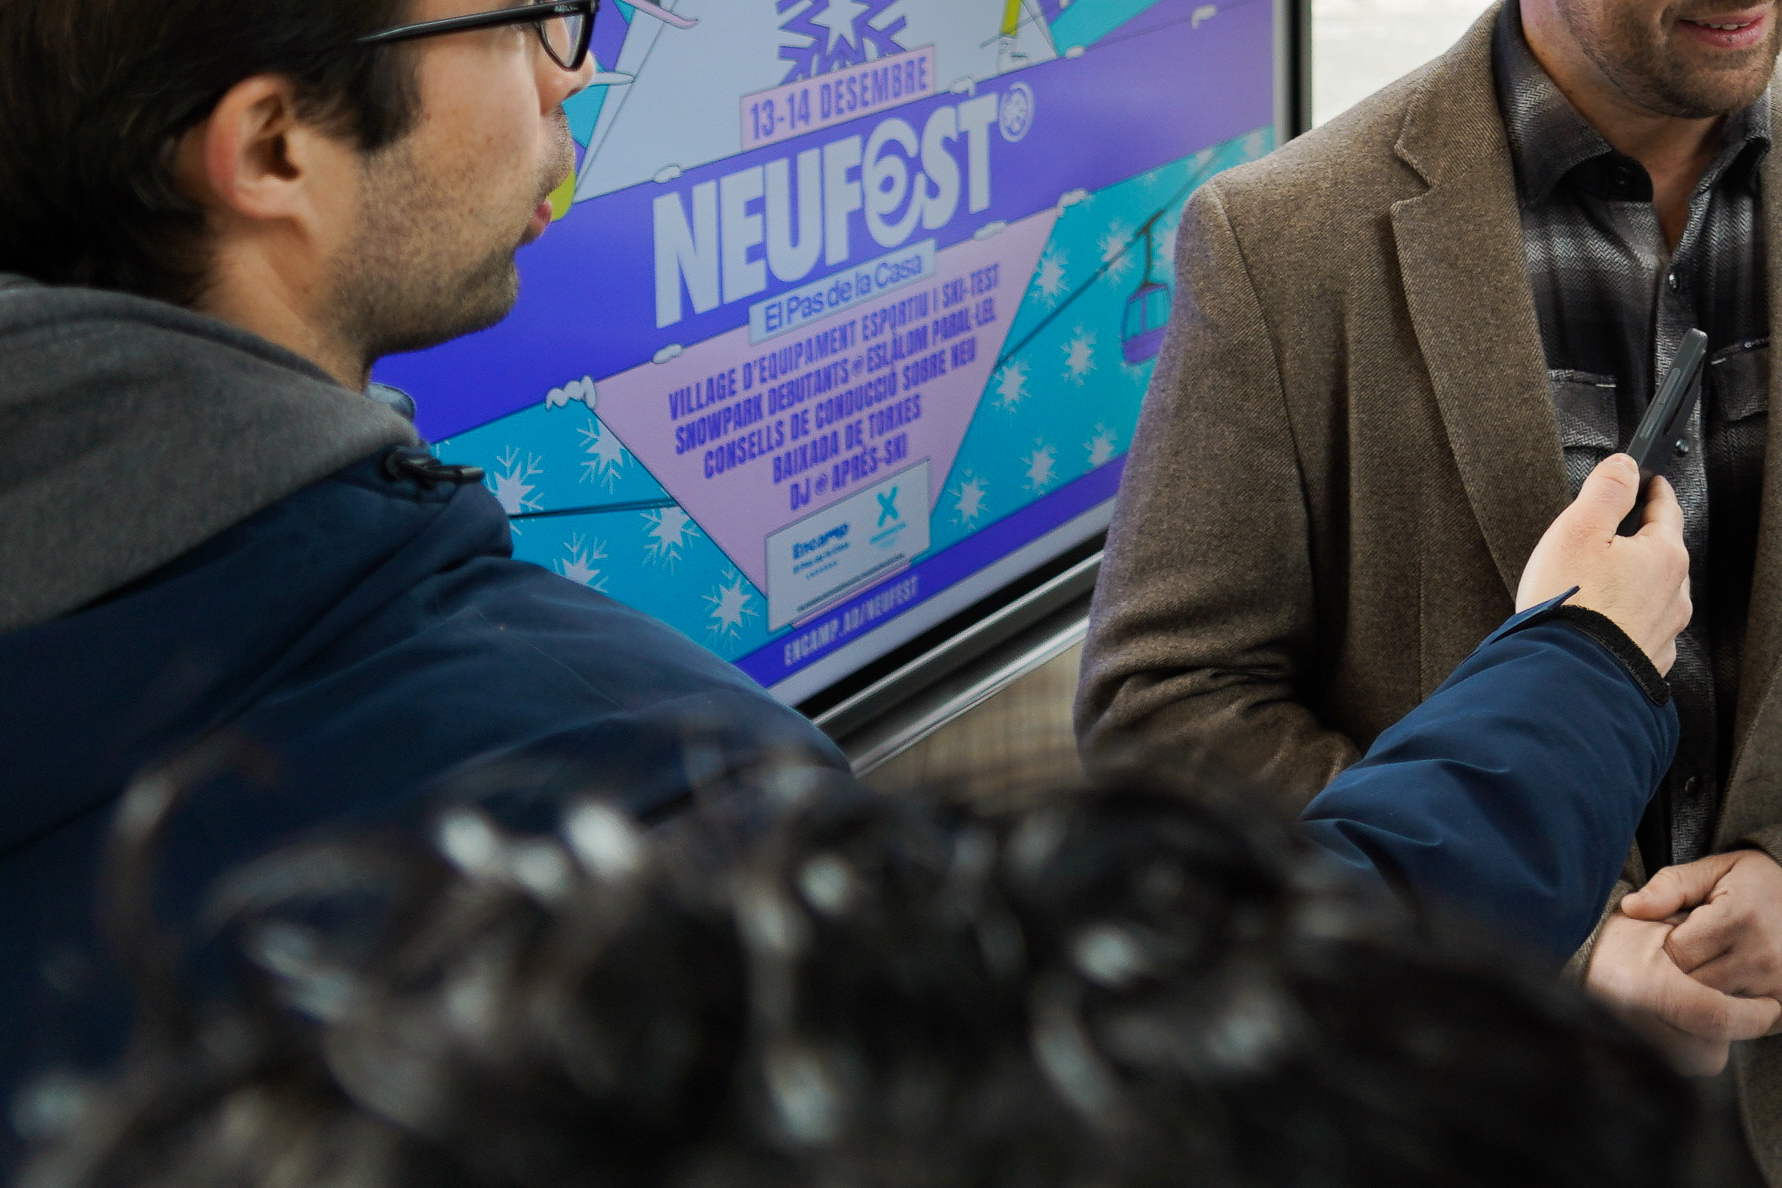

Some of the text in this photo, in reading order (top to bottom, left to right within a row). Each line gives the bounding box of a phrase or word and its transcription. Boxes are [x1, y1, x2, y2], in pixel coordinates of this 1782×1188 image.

[749, 56, 928, 140] 13-14 DESEMBRE
[652, 92, 999, 330] NEUFEST
[764, 254, 923, 333] El Pas de la Casa
[668, 368, 737, 421] VILLAGE
[743, 319, 856, 392] D'EQUIPAMENT
[862, 291, 929, 342] ESPORTIU
[943, 262, 1000, 309] SKI-TEST
[675, 392, 764, 455] SNOWPARK
[767, 358, 850, 416] DEBUTANTS
[704, 419, 785, 480] CONSELLS
[790, 409, 811, 441] DE
[772, 429, 840, 484] BAIXADA
[845, 418, 863, 451] DE
[790, 477, 811, 511] DJ
